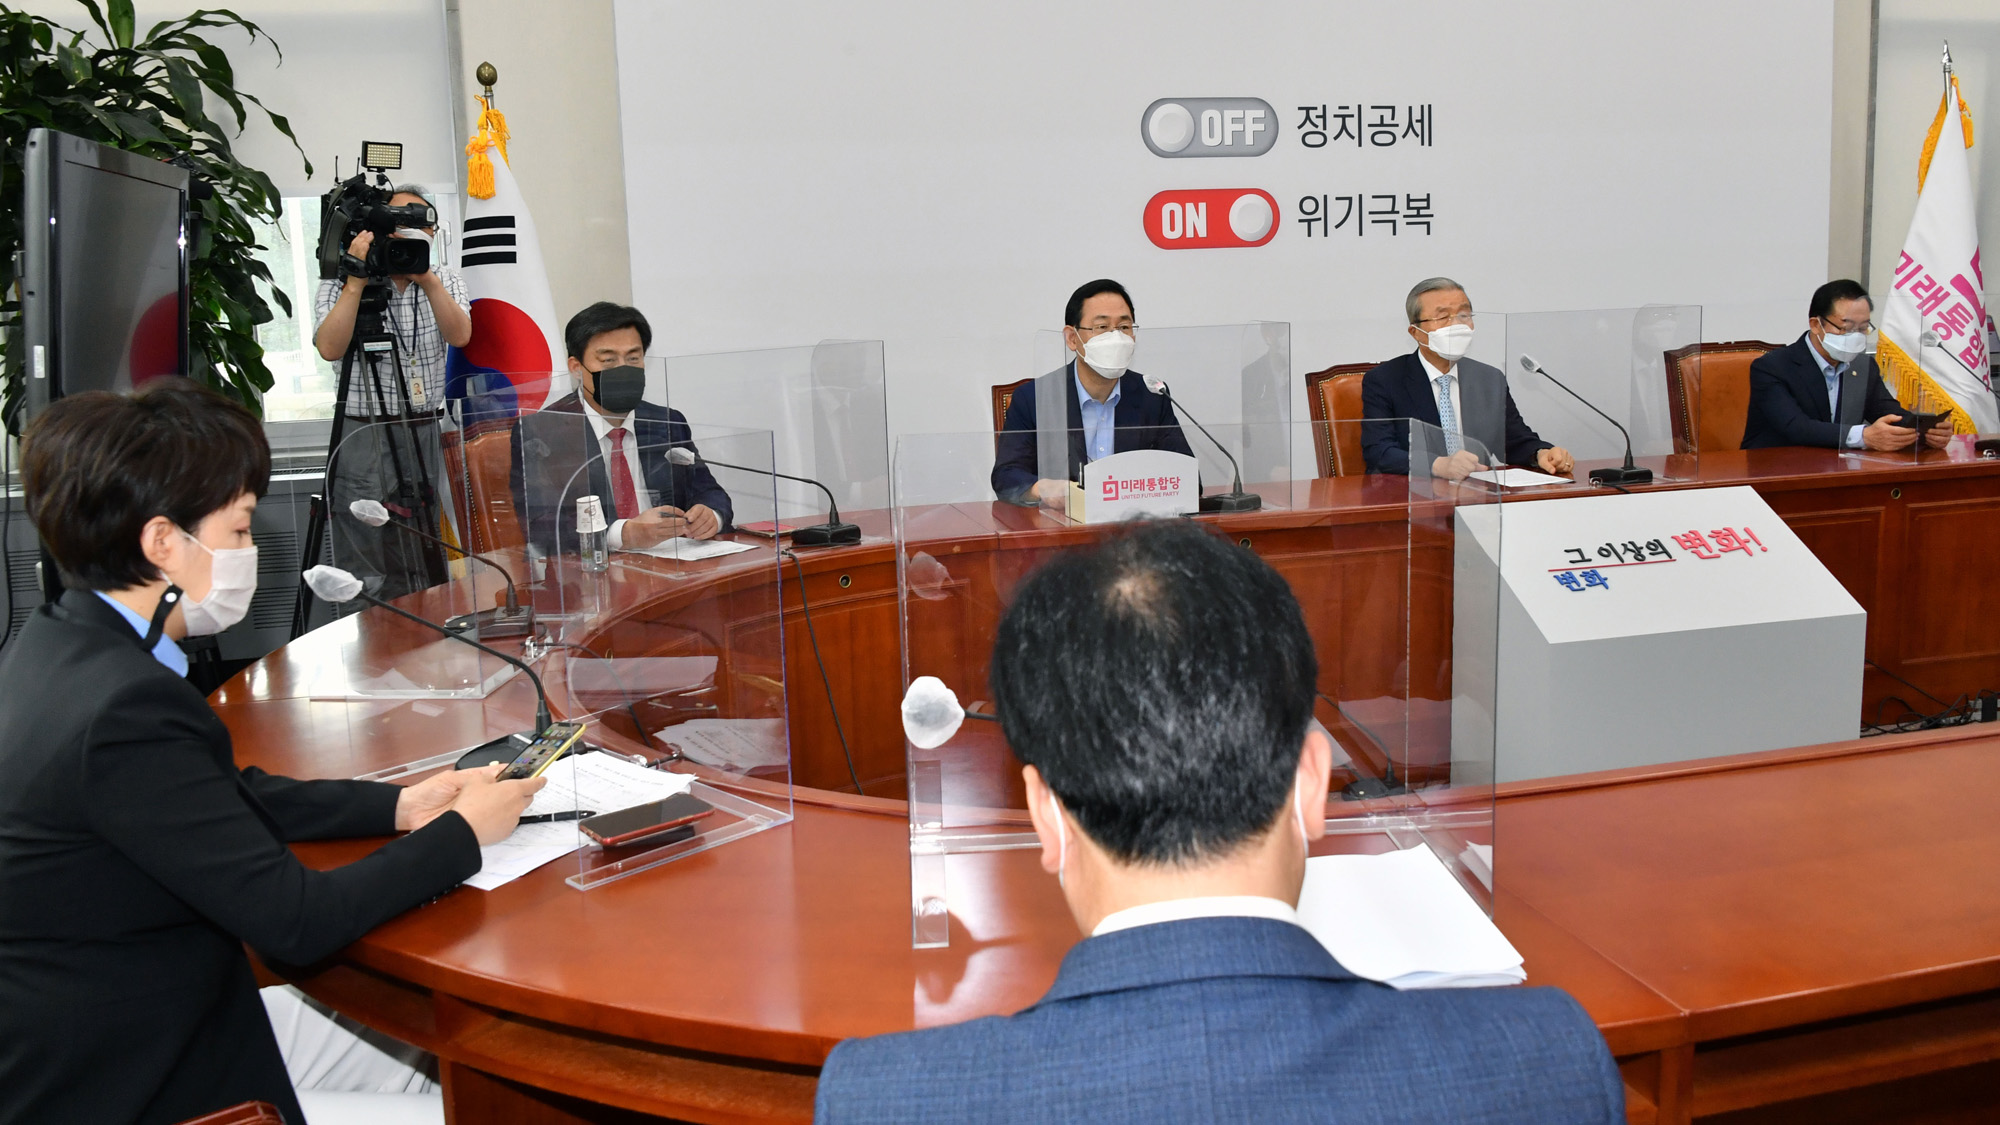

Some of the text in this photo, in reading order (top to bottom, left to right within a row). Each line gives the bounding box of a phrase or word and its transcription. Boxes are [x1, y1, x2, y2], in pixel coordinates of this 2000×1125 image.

[1201, 109, 1265, 147] OFF
[1297, 103, 1433, 148] 정치공세
[1161, 202, 1208, 240] ON
[1298, 192, 1434, 238] 위기극복
[1121, 476, 1181, 492] 미래통합당
[1564, 527, 1768, 564] 그 이상의 변화!
[1553, 569, 1610, 592] 변화
